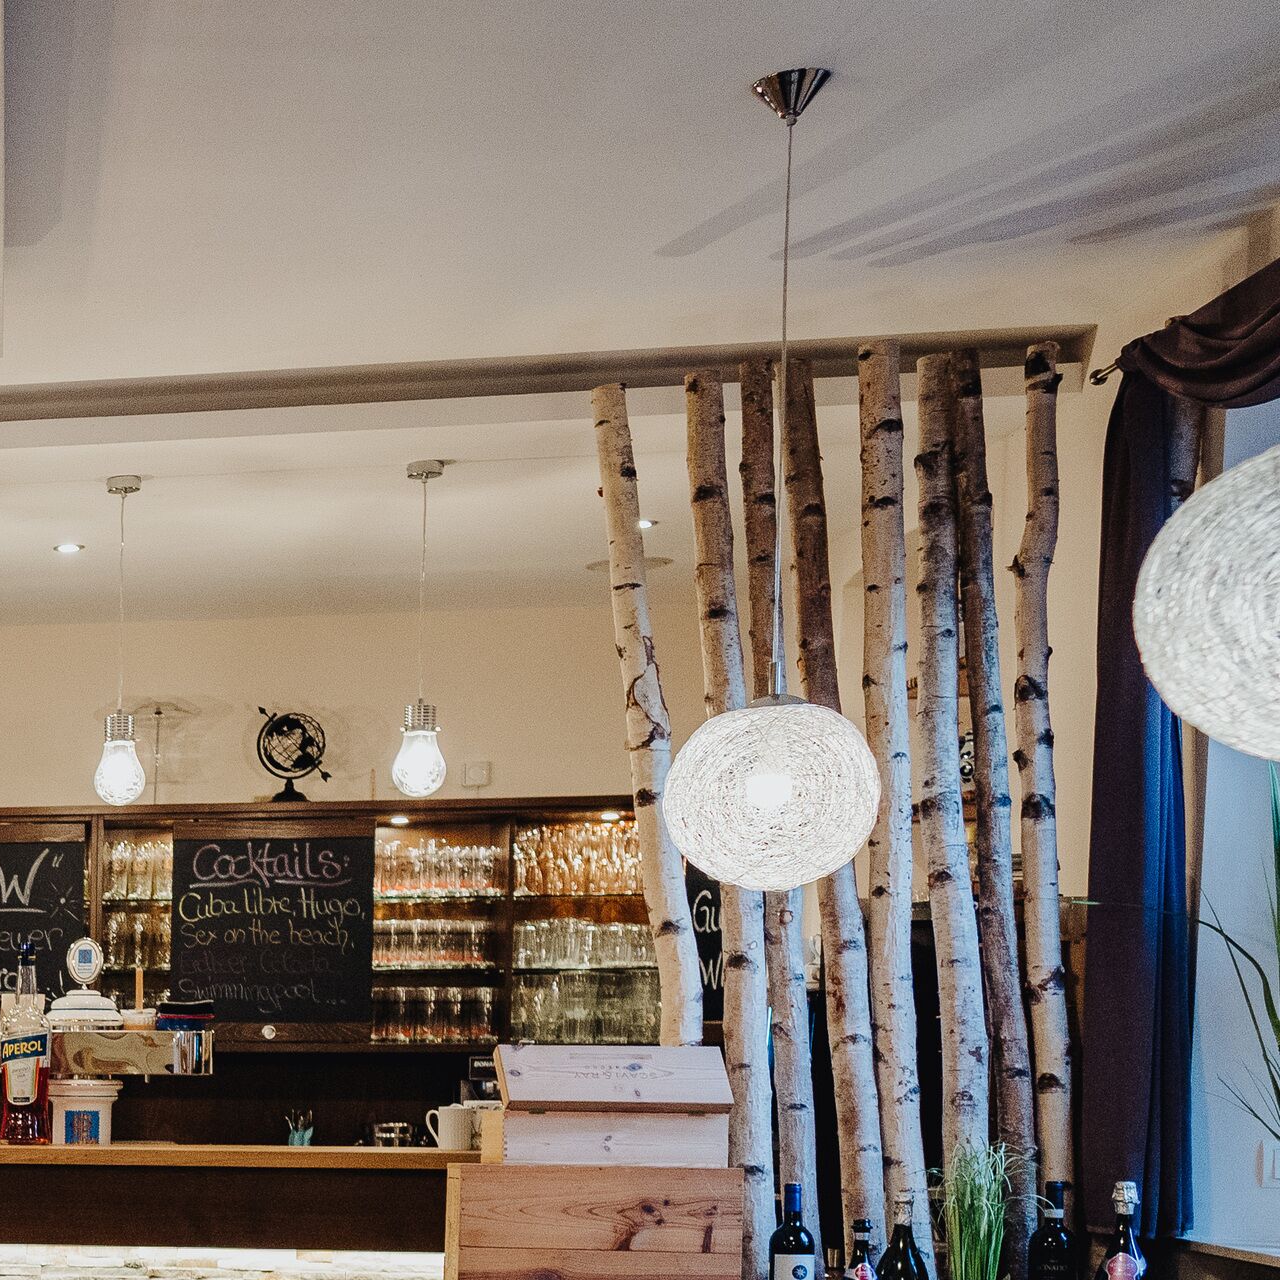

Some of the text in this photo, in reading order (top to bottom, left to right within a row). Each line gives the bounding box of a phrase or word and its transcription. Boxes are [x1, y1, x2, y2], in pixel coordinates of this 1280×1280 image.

[192, 841, 350, 888] Cocktails:
[178, 892, 239, 922] Cuba
[180, 923, 217, 949] Sex
[224, 929, 246, 943] on
[249, 918, 281, 946] the
[2, 1040, 43, 1058] APEROL
